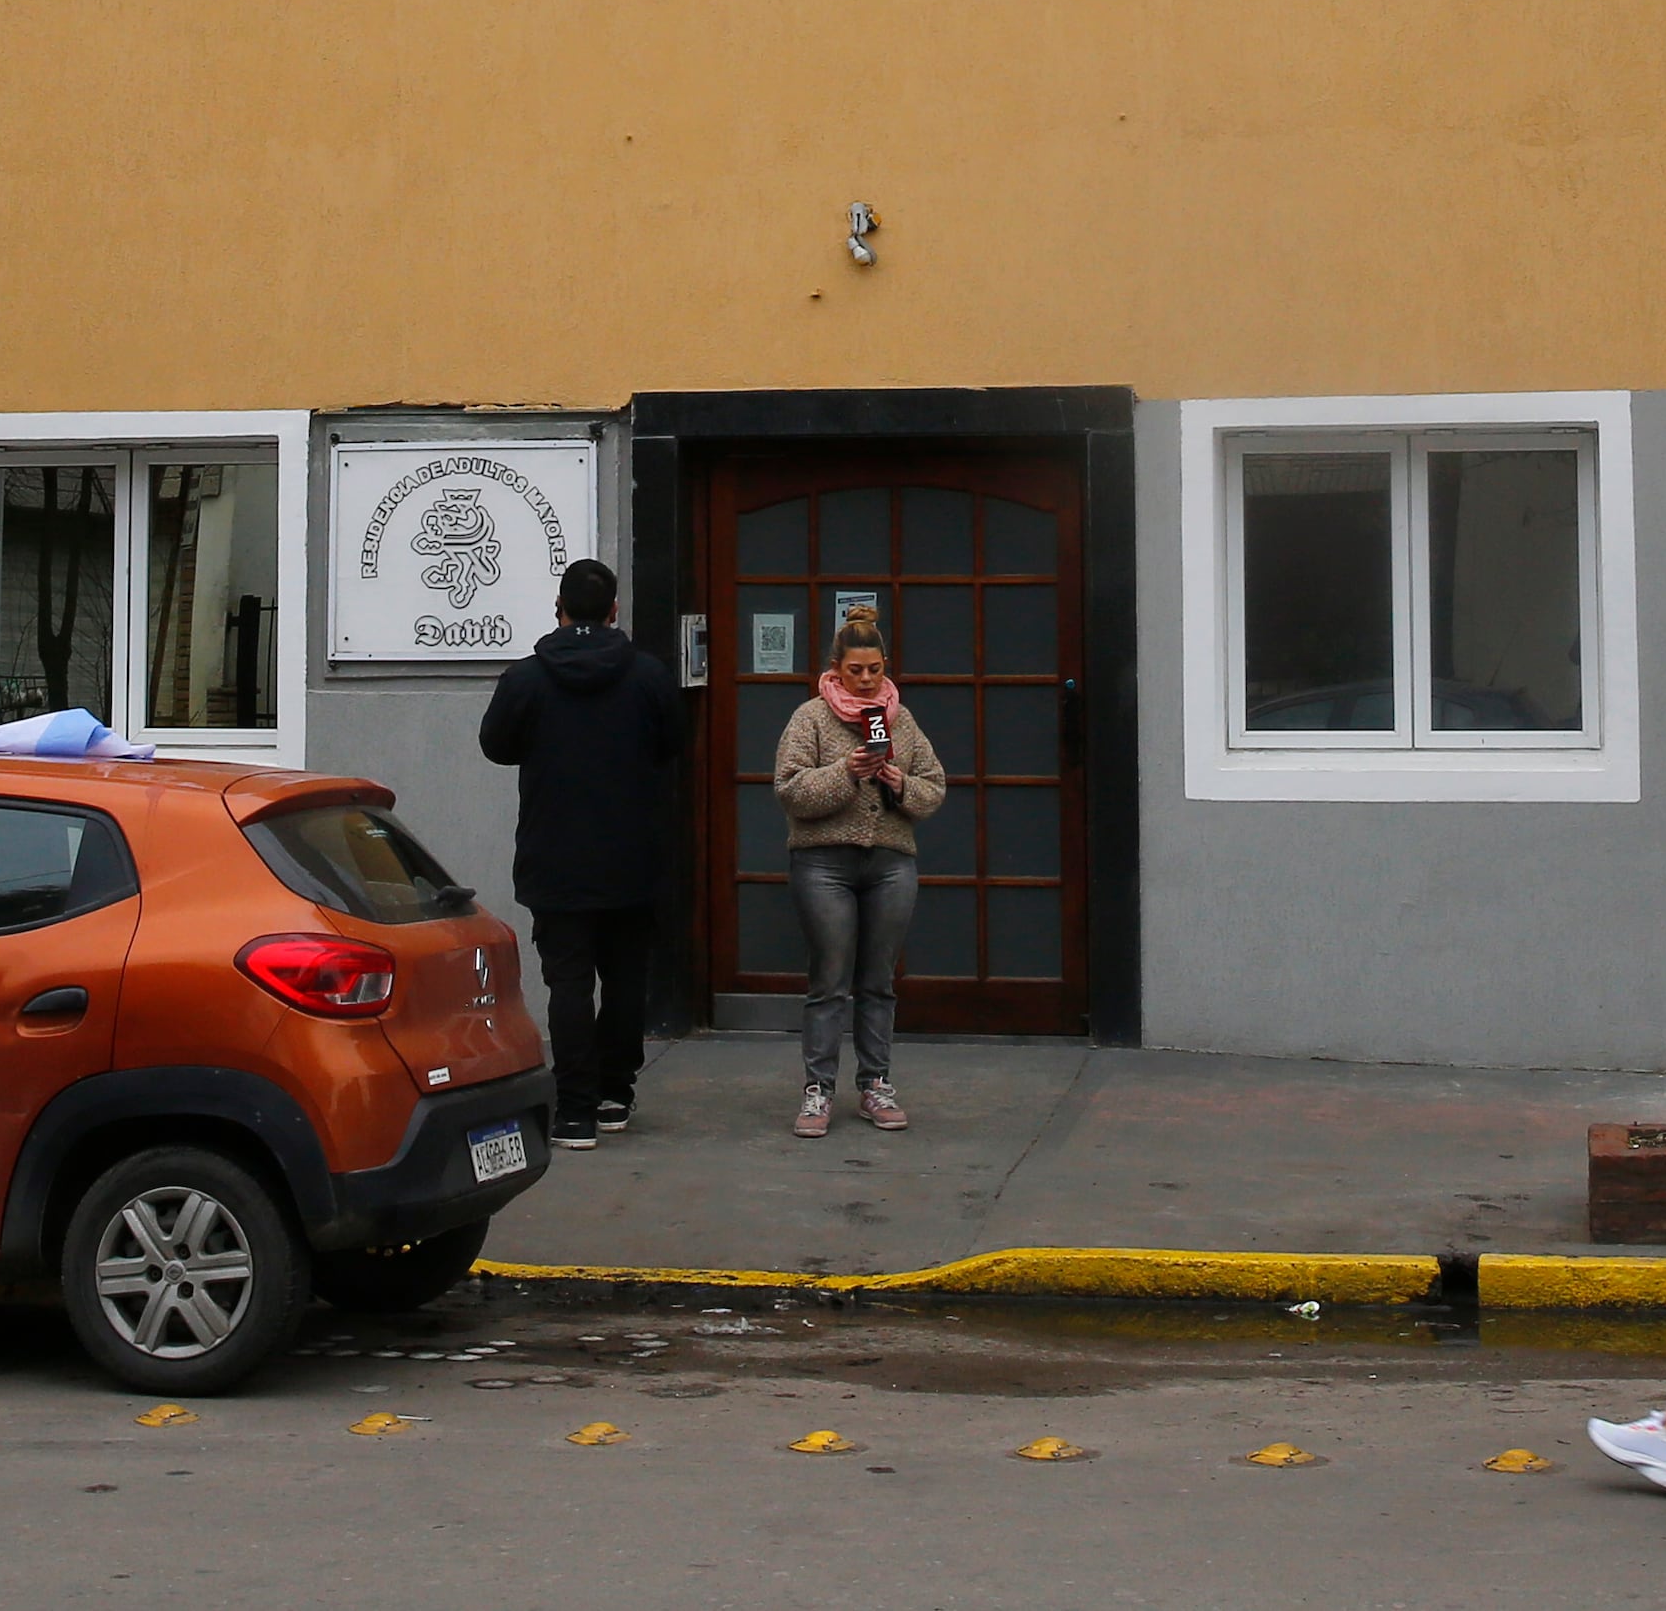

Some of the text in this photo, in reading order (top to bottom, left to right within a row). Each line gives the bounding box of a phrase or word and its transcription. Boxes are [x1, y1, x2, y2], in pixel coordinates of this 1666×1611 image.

[361, 457, 567, 578] RESIDENCIA DE ADULTOS MAYORES
[414, 614, 512, 647] David
